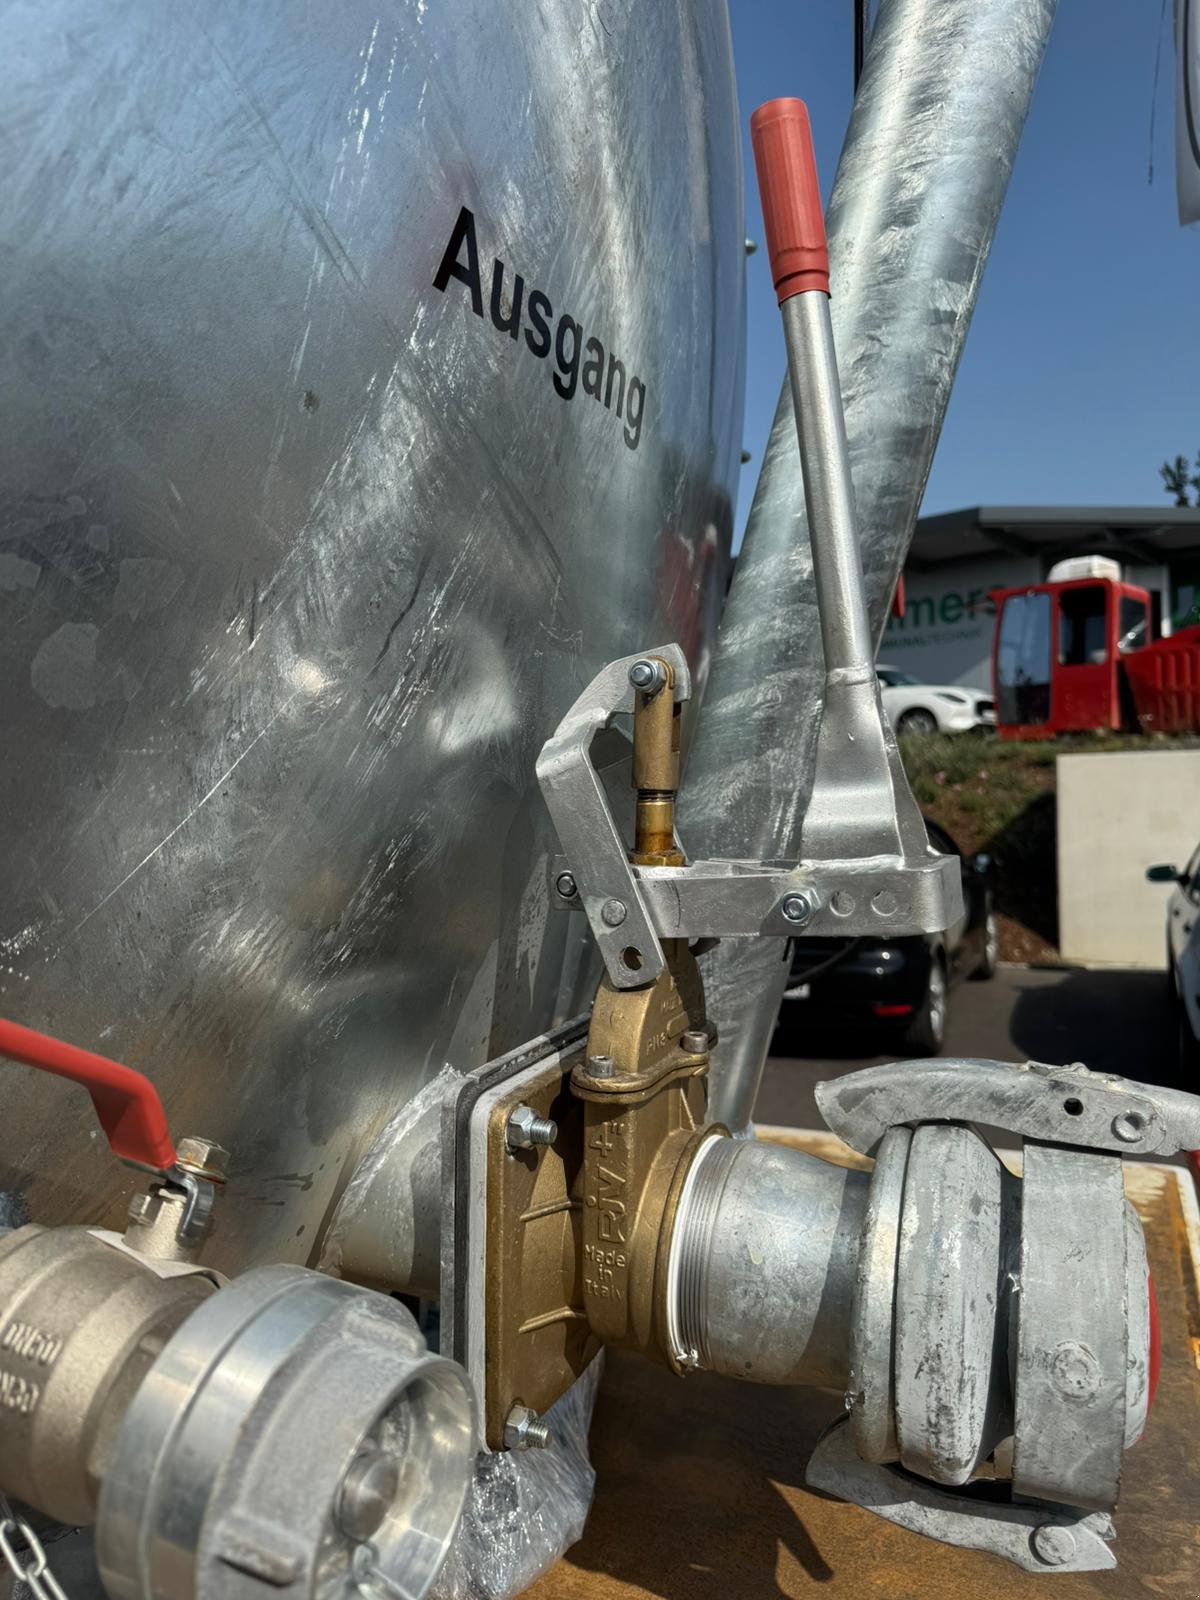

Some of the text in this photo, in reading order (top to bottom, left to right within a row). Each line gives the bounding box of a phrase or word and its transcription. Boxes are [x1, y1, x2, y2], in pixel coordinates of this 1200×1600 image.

[432, 206, 646, 450] Ausgang
[585, 1244, 626, 1267] Made
[599, 1263, 613, 1281] in
